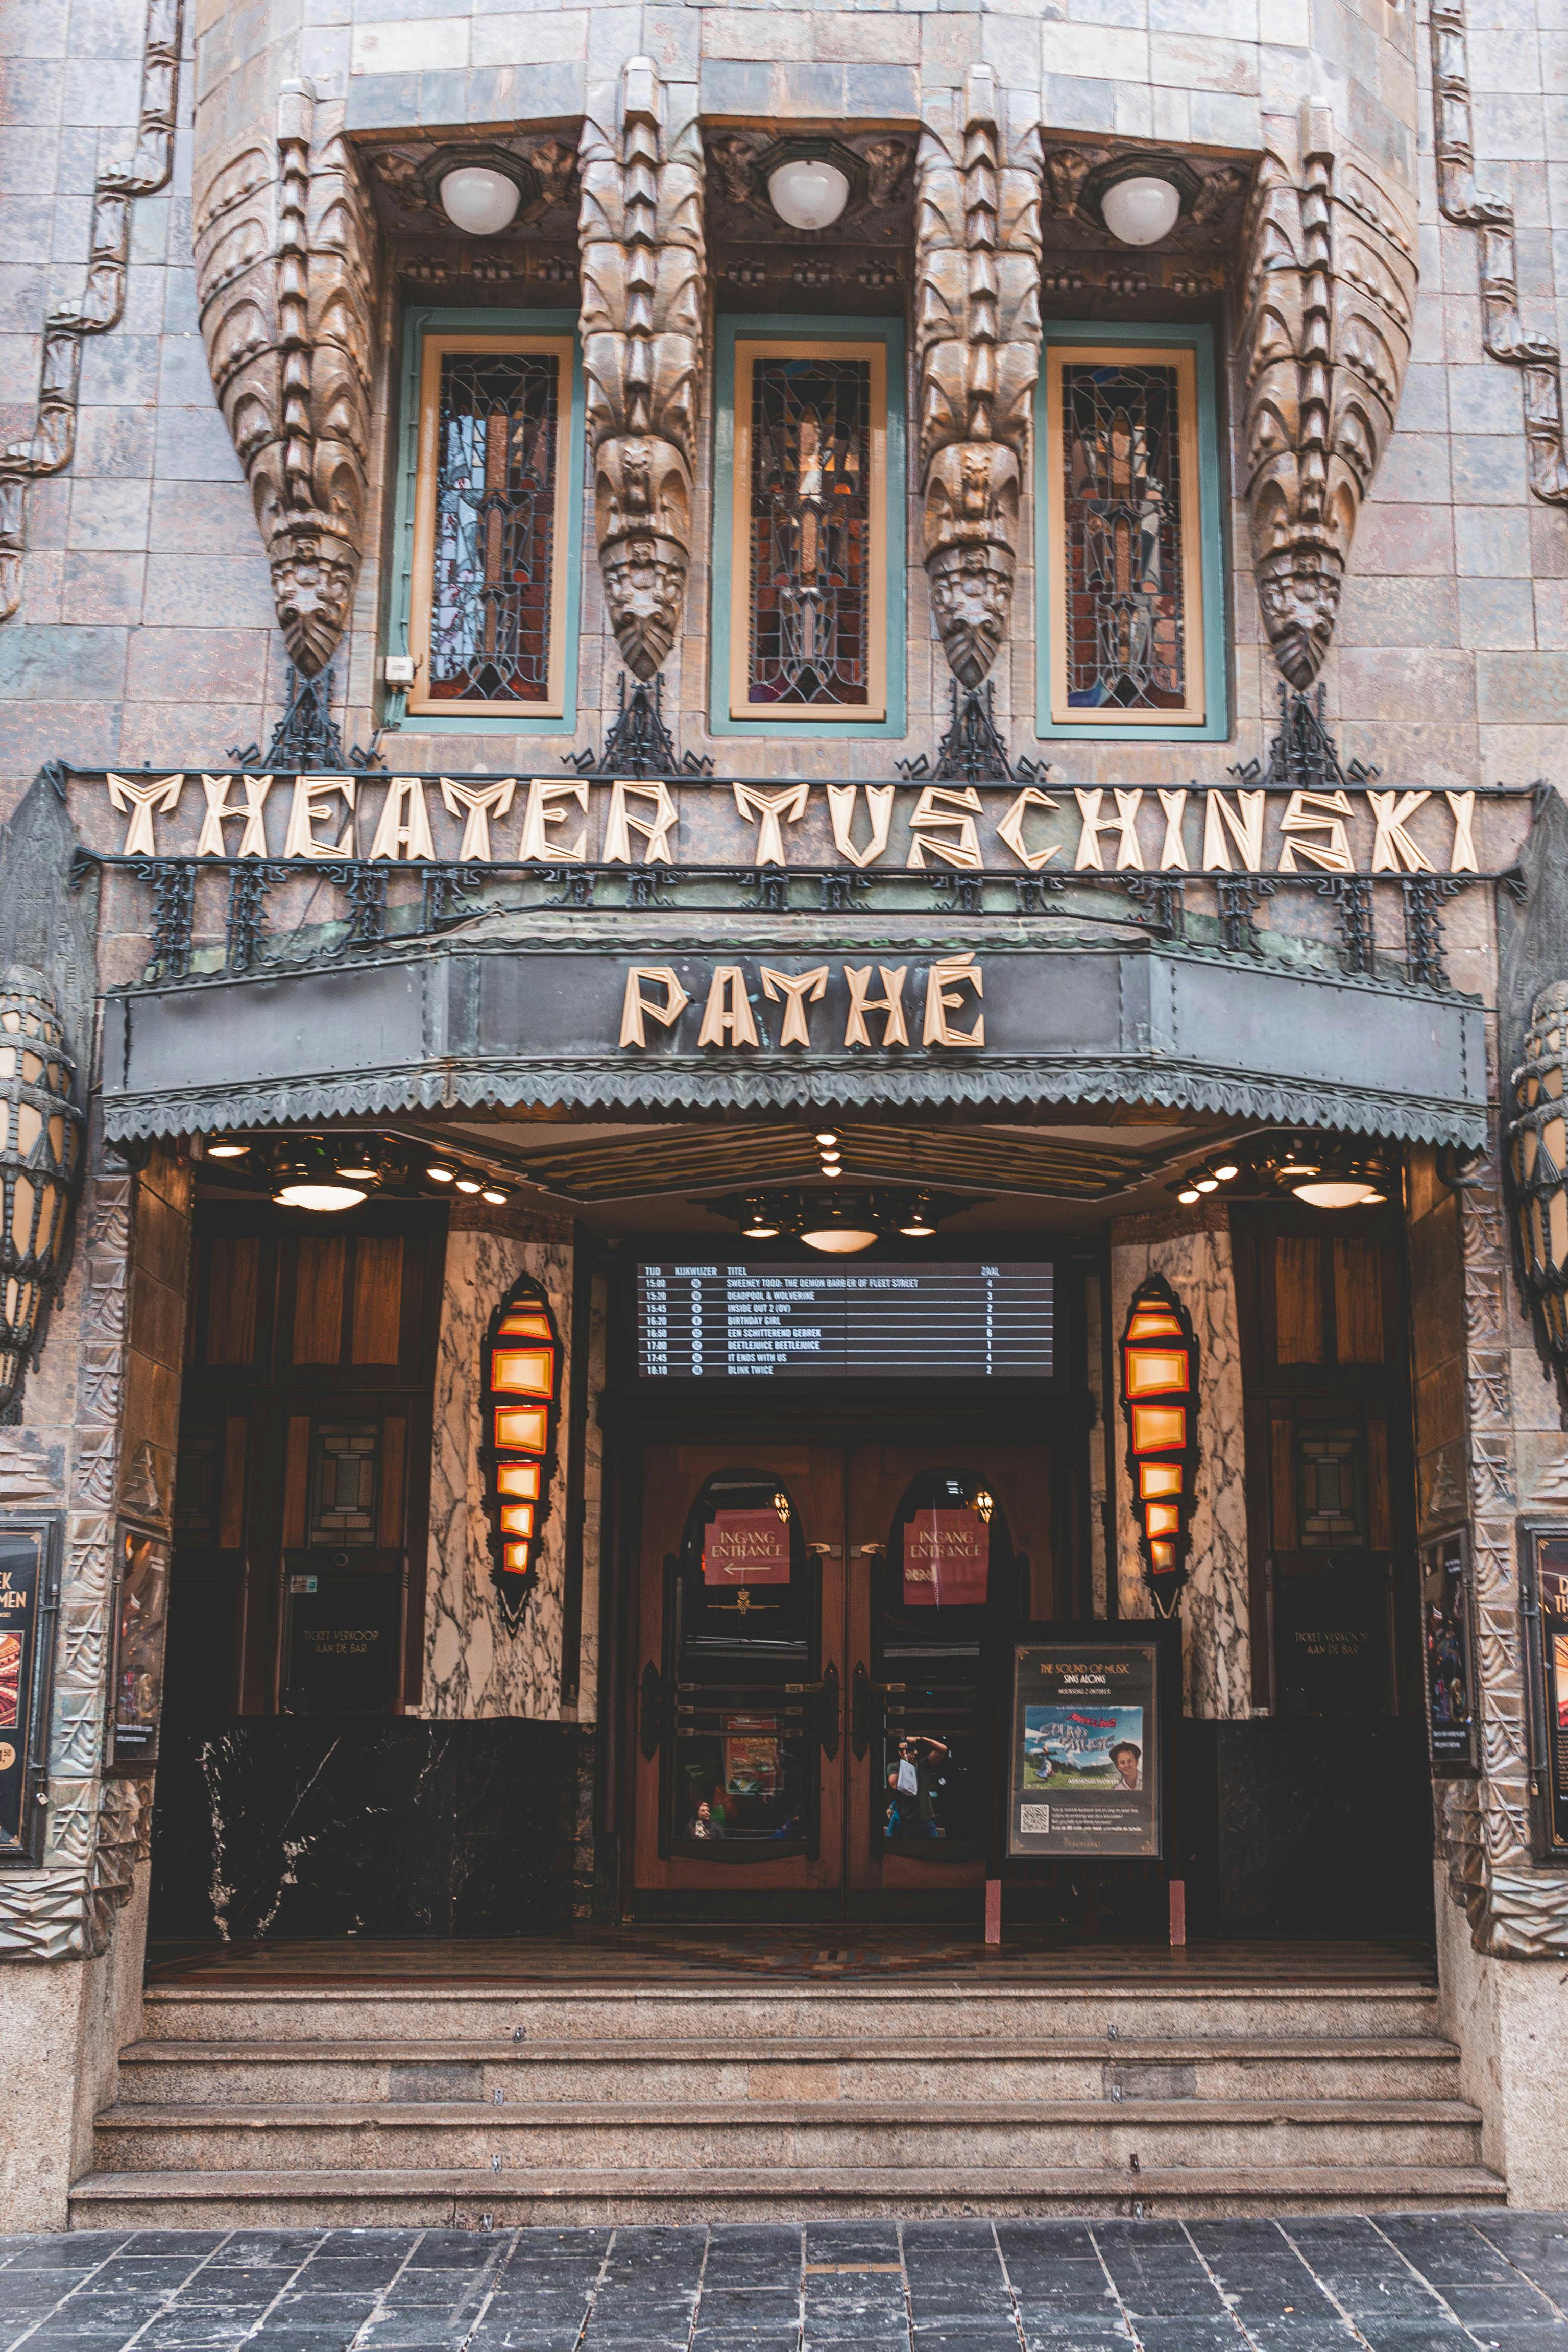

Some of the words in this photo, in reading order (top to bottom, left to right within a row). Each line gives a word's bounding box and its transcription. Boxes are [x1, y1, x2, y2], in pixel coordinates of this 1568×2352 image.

[106, 773, 678, 865] THEATER
[732, 782, 1479, 873] TUSCHINSKI
[619, 952, 985, 1048] PATHÉ
[727, 1266, 748, 1276] TITEL
[981, 1266, 1000, 1276] ZAAL
[646, 1279, 666, 1288] 15:00
[727, 1279, 760, 1287] SWEENEY
[762, 1279, 783, 1287] TODD:
[784, 1279, 799, 1287] THE
[800, 1279, 825, 1287] DEMON
[827, 1279, 857, 1287] BARBER
[858, 1279, 868, 1287] OF
[869, 1279, 891, 1287] FLEET
[892, 1279, 919, 1287] STREET
[986, 1279, 993, 1287] 4
[646, 1291, 667, 1300] 15:20
[727, 1291, 764, 1300] DEADPOOL
[766, 1291, 773, 1300] &
[773, 1291, 815, 1300] WOLVERINE
[986, 1291, 993, 1300] 3
[646, 1304, 667, 1313] 15:45
[728, 1304, 752, 1313] INSIDE
[753, 1304, 767, 1313] OUT
[769, 1304, 774, 1313] 2
[775, 1304, 791, 1313] (OV)
[986, 1304, 993, 1312] 2
[647, 1316, 667, 1325] 16:20
[728, 1316, 763, 1325] BIRTHDAY
[764, 1316, 781, 1325] GIRL
[986, 1316, 993, 1325] 5
[647, 1329, 667, 1337] 16:50
[728, 1329, 742, 1337] EEN
[743, 1329, 791, 1337] SCHITTEREND
[793, 1329, 822, 1337] GEBREK
[986, 1329, 993, 1337] 6
[647, 1341, 667, 1350] 17:00
[728, 1341, 774, 1350] BEETLEJUICE
[775, 1341, 821, 1350] BEETLEJUICE
[987, 1341, 992, 1349] 1
[647, 1354, 667, 1362] 17:45
[728, 1353, 735, 1362] IT
[736, 1353, 756, 1362] ENDS
[757, 1353, 776, 1362] WITH
[777, 1353, 787, 1362] US
[986, 1353, 992, 1361] 4
[647, 1366, 668, 1375] 18:10
[728, 1365, 750, 1375] BLINK
[751, 1365, 774, 1375] TWICE
[986, 1365, 992, 1374] 2
[720, 1531, 775, 1544] INGANG
[920, 1531, 974, 1543] INGANG
[712, 1545, 783, 1557] ENTRANCE
[910, 1544, 982, 1558] ENTRANCE
[305, 1631, 330, 1641] TICKET
[333, 1630, 379, 1641] VERKOOP
[1295, 1631, 1321, 1642] TICKET
[315, 1644, 333, 1653] AAN
[336, 1644, 347, 1653] DE
[350, 1644, 368, 1653] BAR
[1307, 1645, 1325, 1654] AAN
[1040, 1663, 1053, 1674] THE
[1055, 1663, 1088, 1674] SOUND
[1089, 1663, 1103, 1674] OF
[1105, 1663, 1130, 1674] MUSIC
[1064, 1674, 1079, 1684] SING
[1080, 1674, 1106, 1684] ALONG
